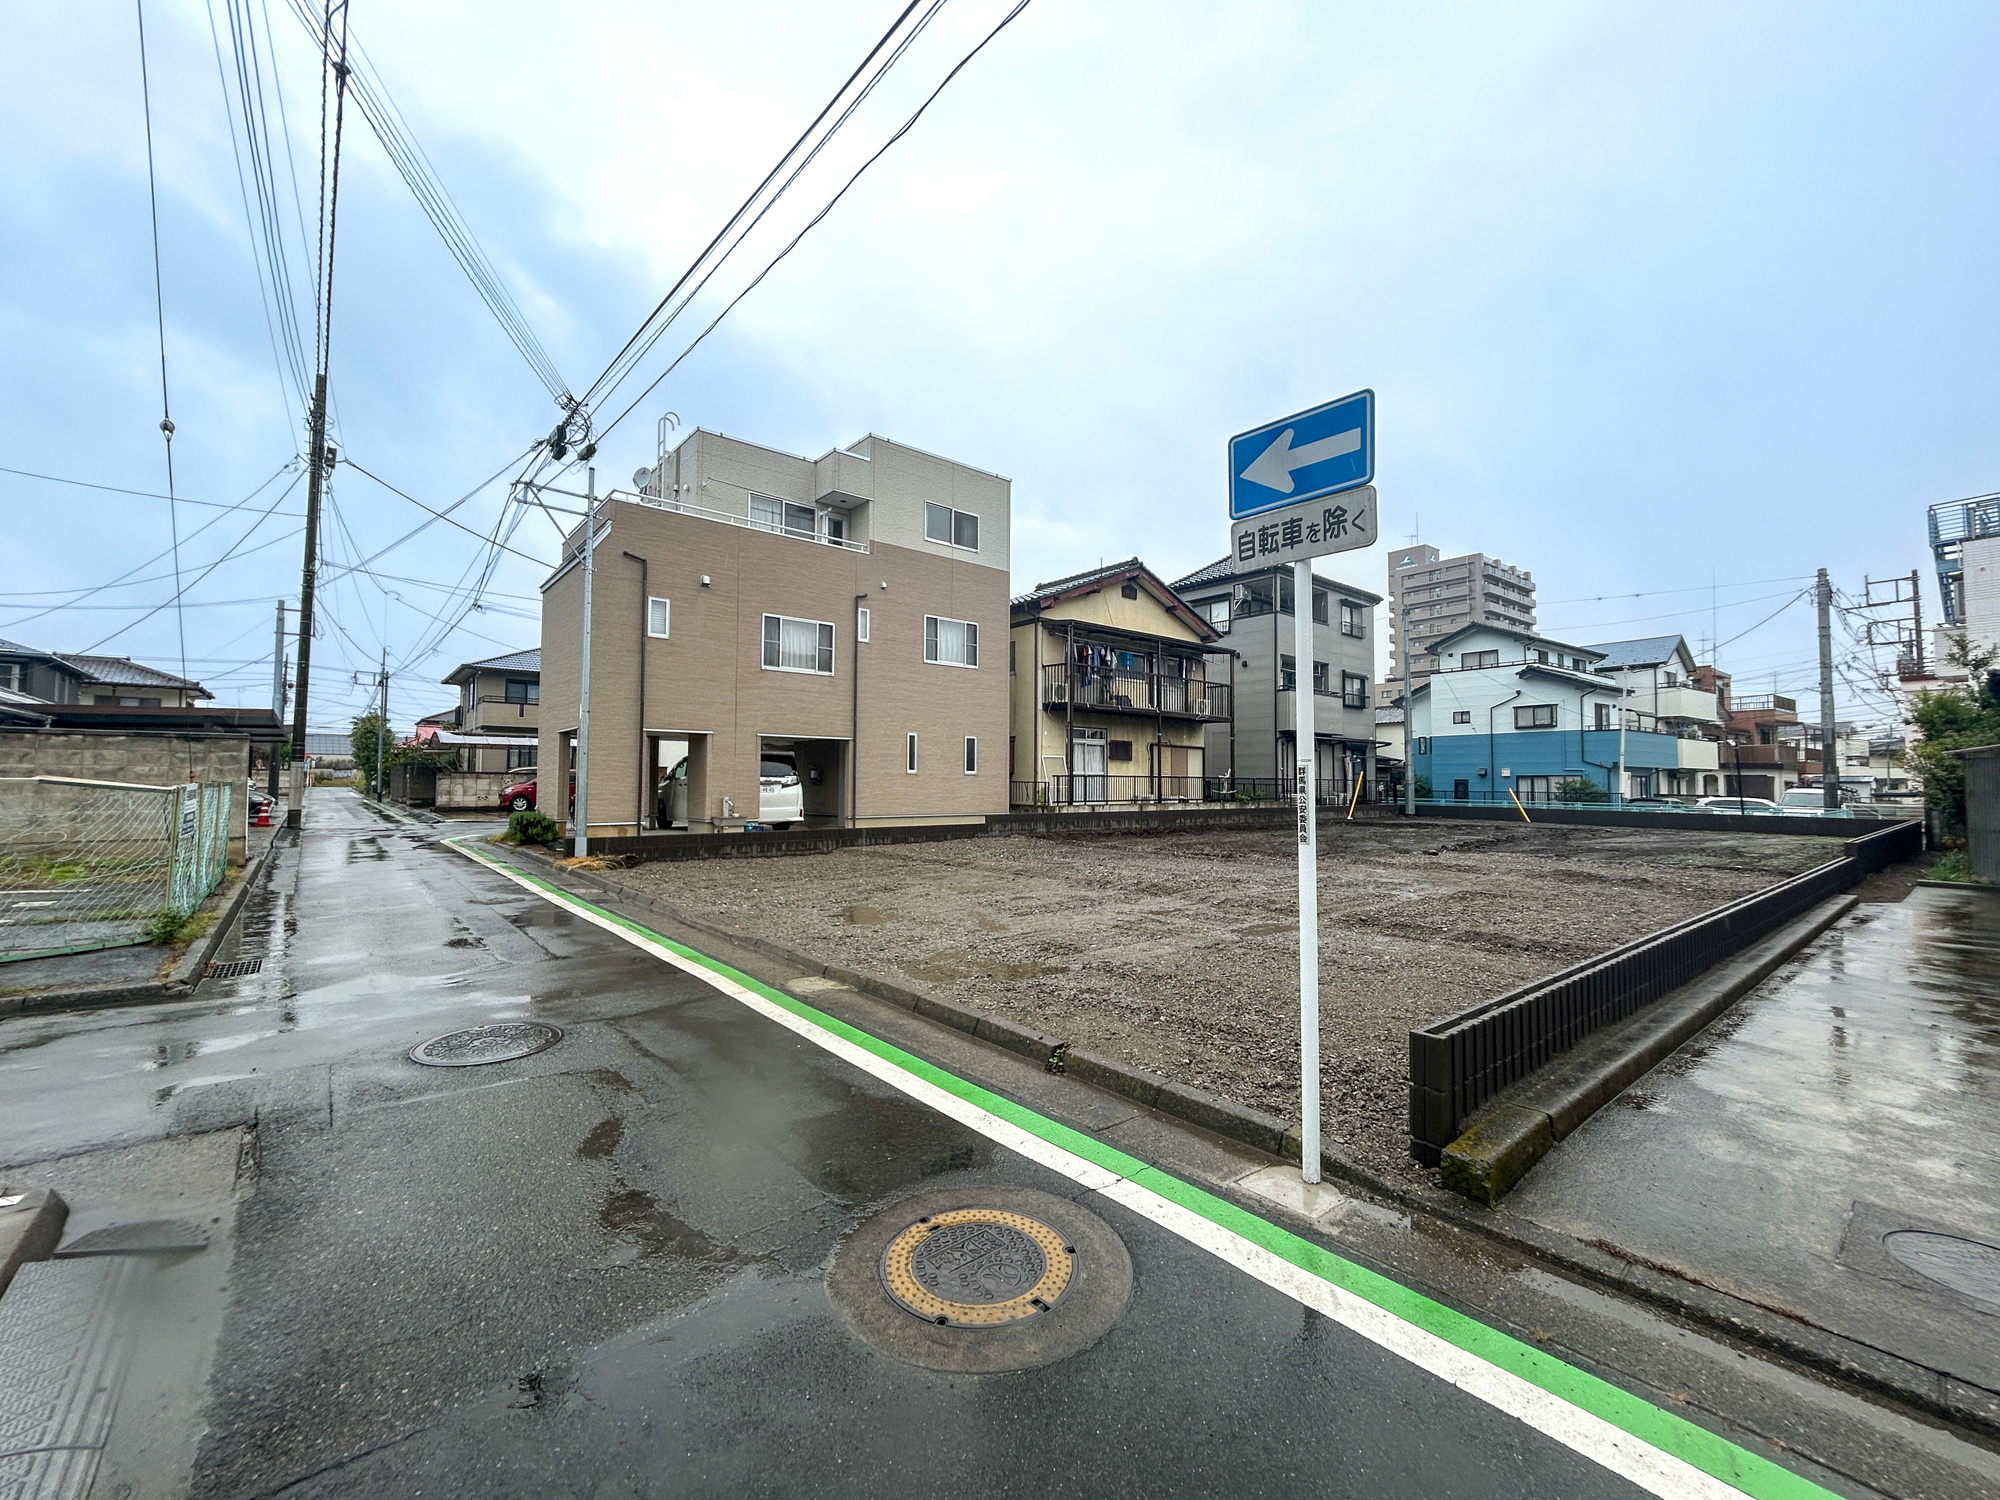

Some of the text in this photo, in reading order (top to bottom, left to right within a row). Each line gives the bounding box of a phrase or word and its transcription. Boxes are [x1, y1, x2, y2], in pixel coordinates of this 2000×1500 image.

[1238, 505, 1366, 562] 自転車を除く
[1298, 766, 1307, 843] 群馬県公安委員会
